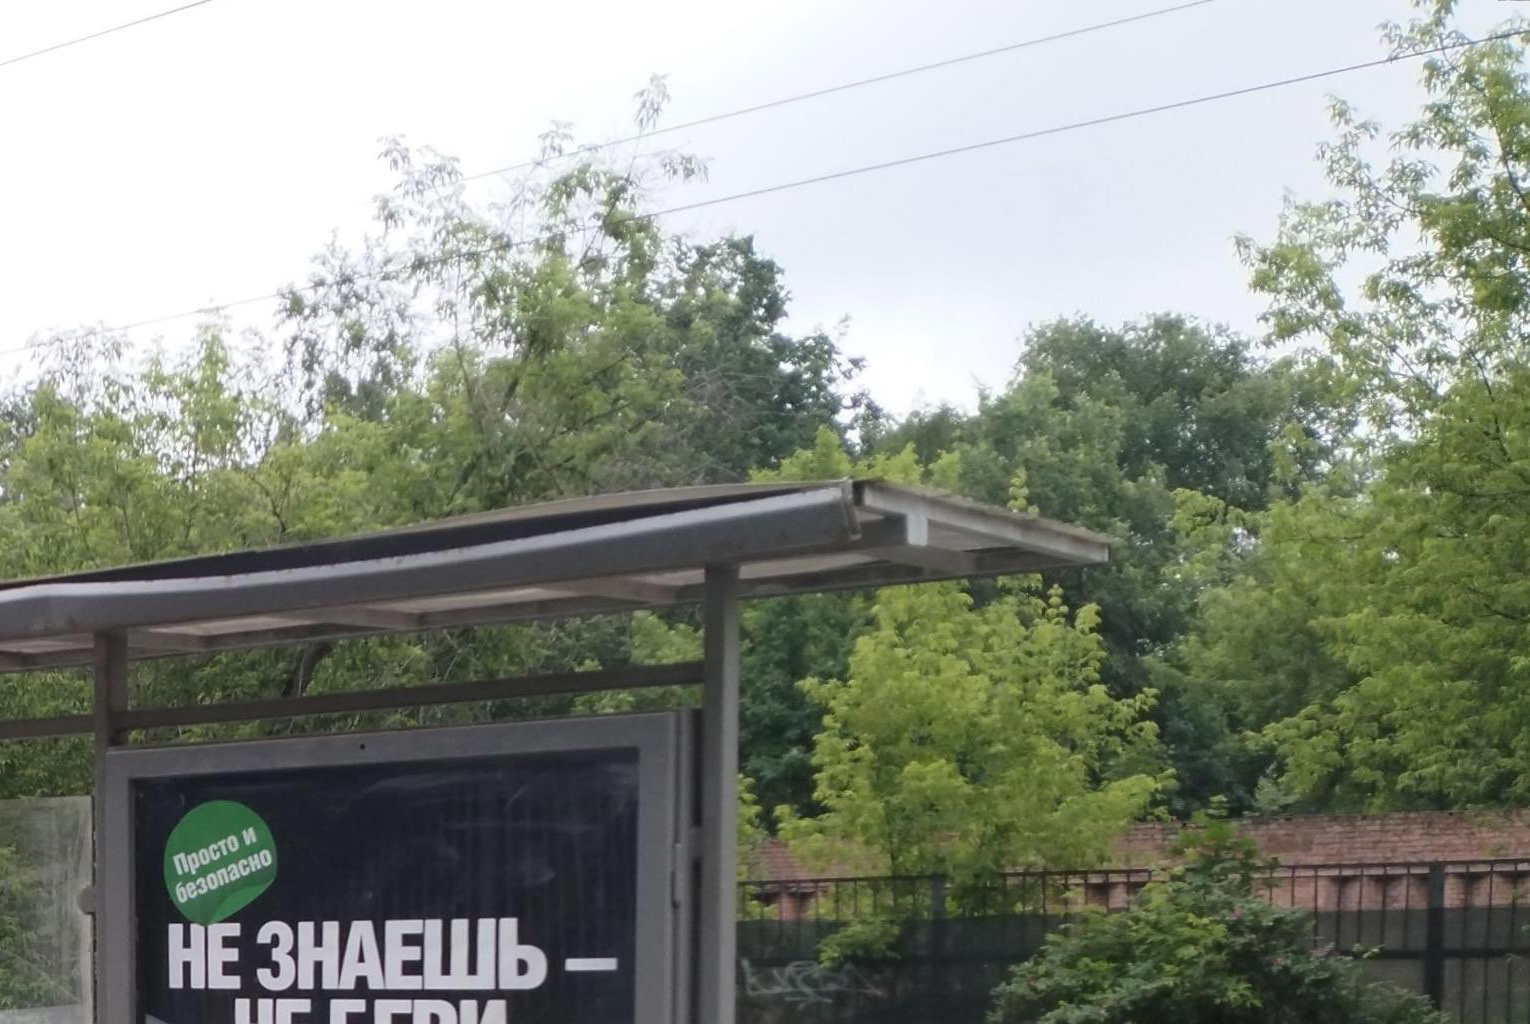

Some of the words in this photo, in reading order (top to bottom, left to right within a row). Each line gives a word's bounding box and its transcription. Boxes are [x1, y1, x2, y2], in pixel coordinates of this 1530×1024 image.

[172, 834, 239, 875] Просто
[242, 827, 257, 846] и
[175, 849, 272, 903] безопасно
[167, 921, 241, 990] НЕ
[256, 917, 548, 991] ЗНАЕШЬ
